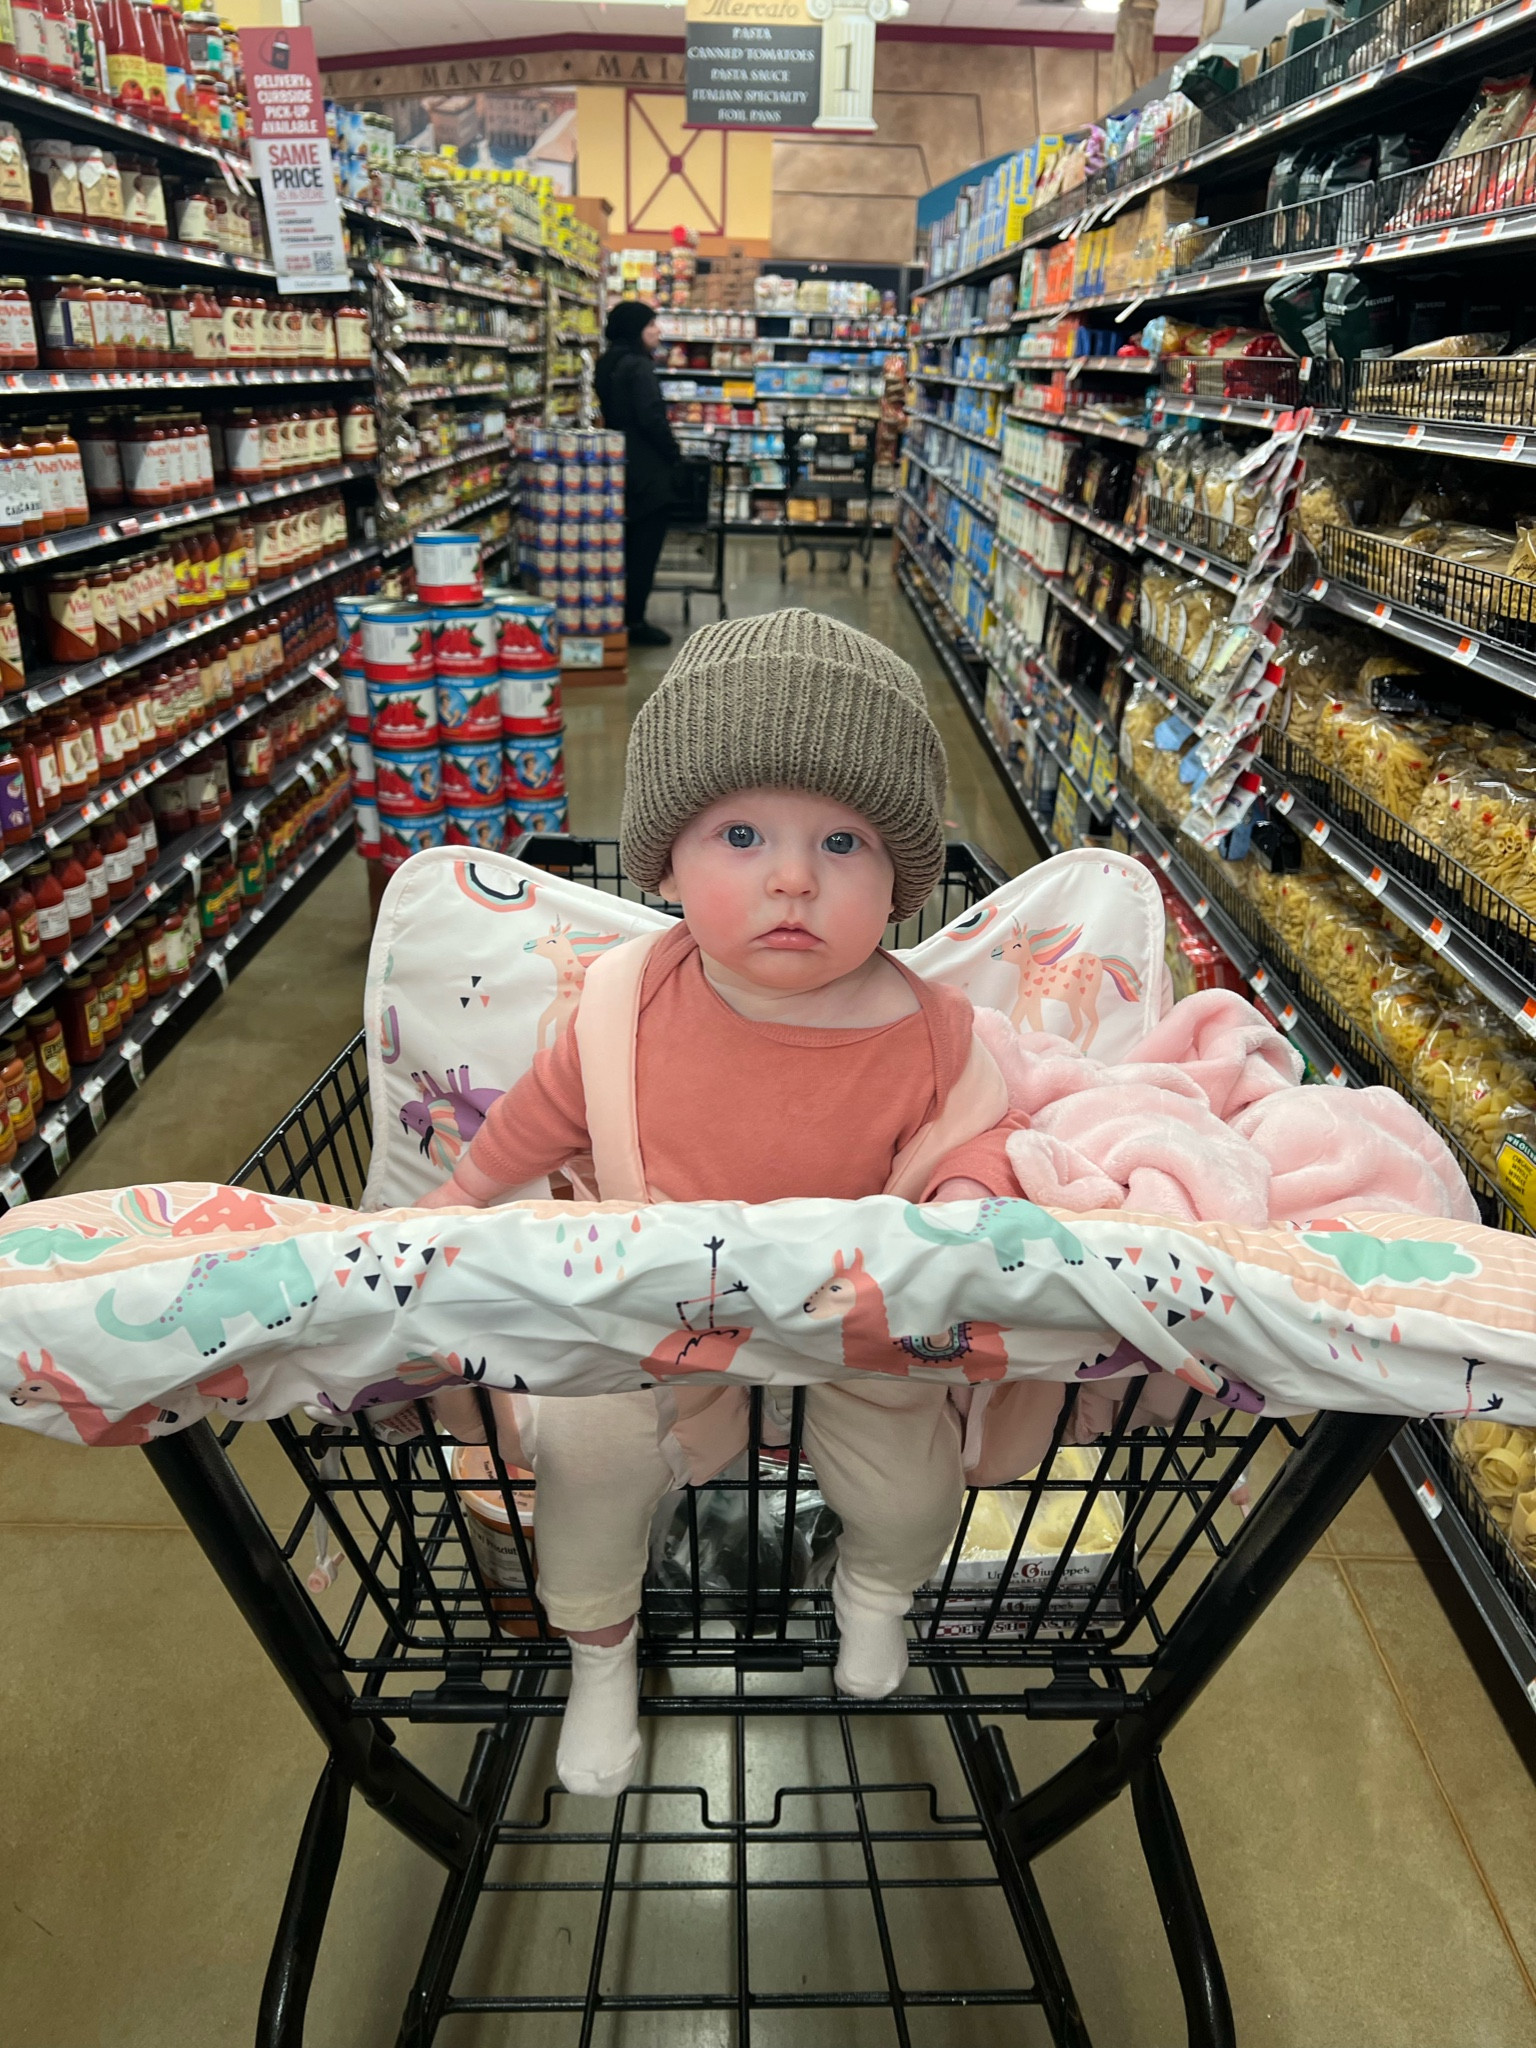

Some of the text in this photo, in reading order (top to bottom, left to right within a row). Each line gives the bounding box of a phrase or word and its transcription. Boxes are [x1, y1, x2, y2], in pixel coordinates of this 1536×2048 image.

[704, 0, 799, 18] Mercato
[732, 27, 772, 40] PASTA
[687, 46, 815, 62] CANNED TOMATOES
[421, 58, 528, 87] MANZO
[711, 68, 790, 82] PASTA SAUCE
[834, 43, 860, 92] 1
[253, 74, 305, 89] DELIVERY
[257, 89, 314, 104] CURBSIDE
[692, 88, 809, 104] ITALIAN SPECIALTY
[264, 105, 310, 119] PICK-UP
[718, 108, 781, 123] FOIL PANS
[261, 119, 319, 135] AVAILABLE
[269, 144, 321, 166] SAME
[272, 167, 324, 188] PRICE
[962, 1621, 1018, 1636] FRSH
